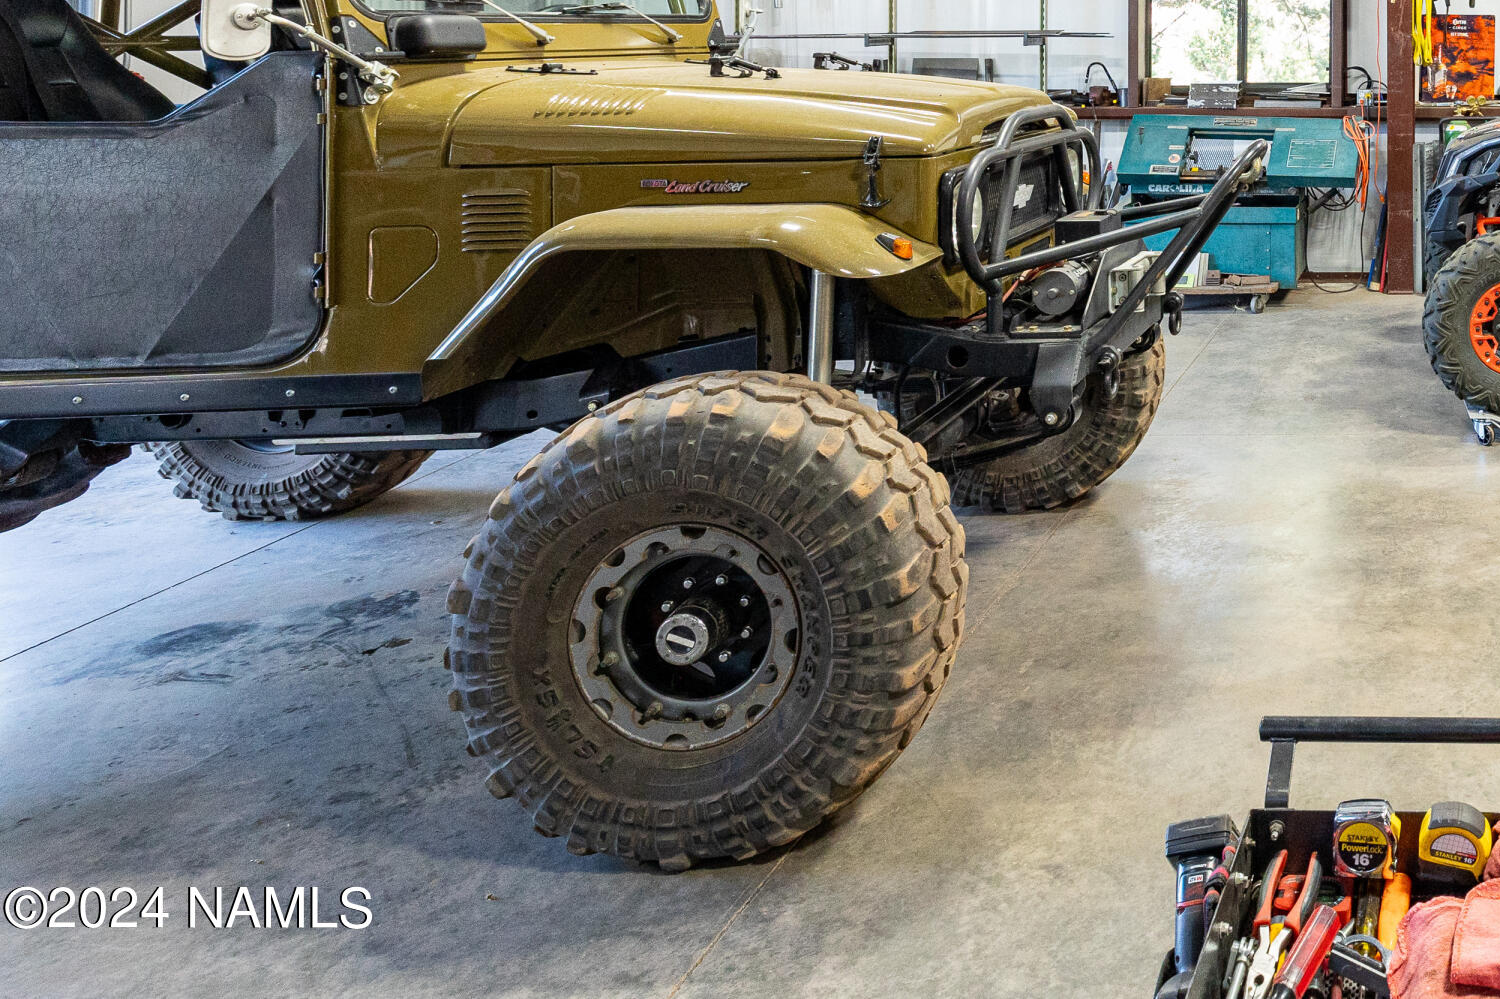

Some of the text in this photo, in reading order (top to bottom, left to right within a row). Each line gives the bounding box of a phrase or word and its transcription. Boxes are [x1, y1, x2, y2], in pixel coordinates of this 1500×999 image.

[664, 180, 700, 193] Land
[699, 179, 749, 193] Cruiser
[1347, 834, 1379, 842] STANLEY
[1341, 844, 1384, 854] PowerLock
[1435, 851, 1462, 862] STANLEY
